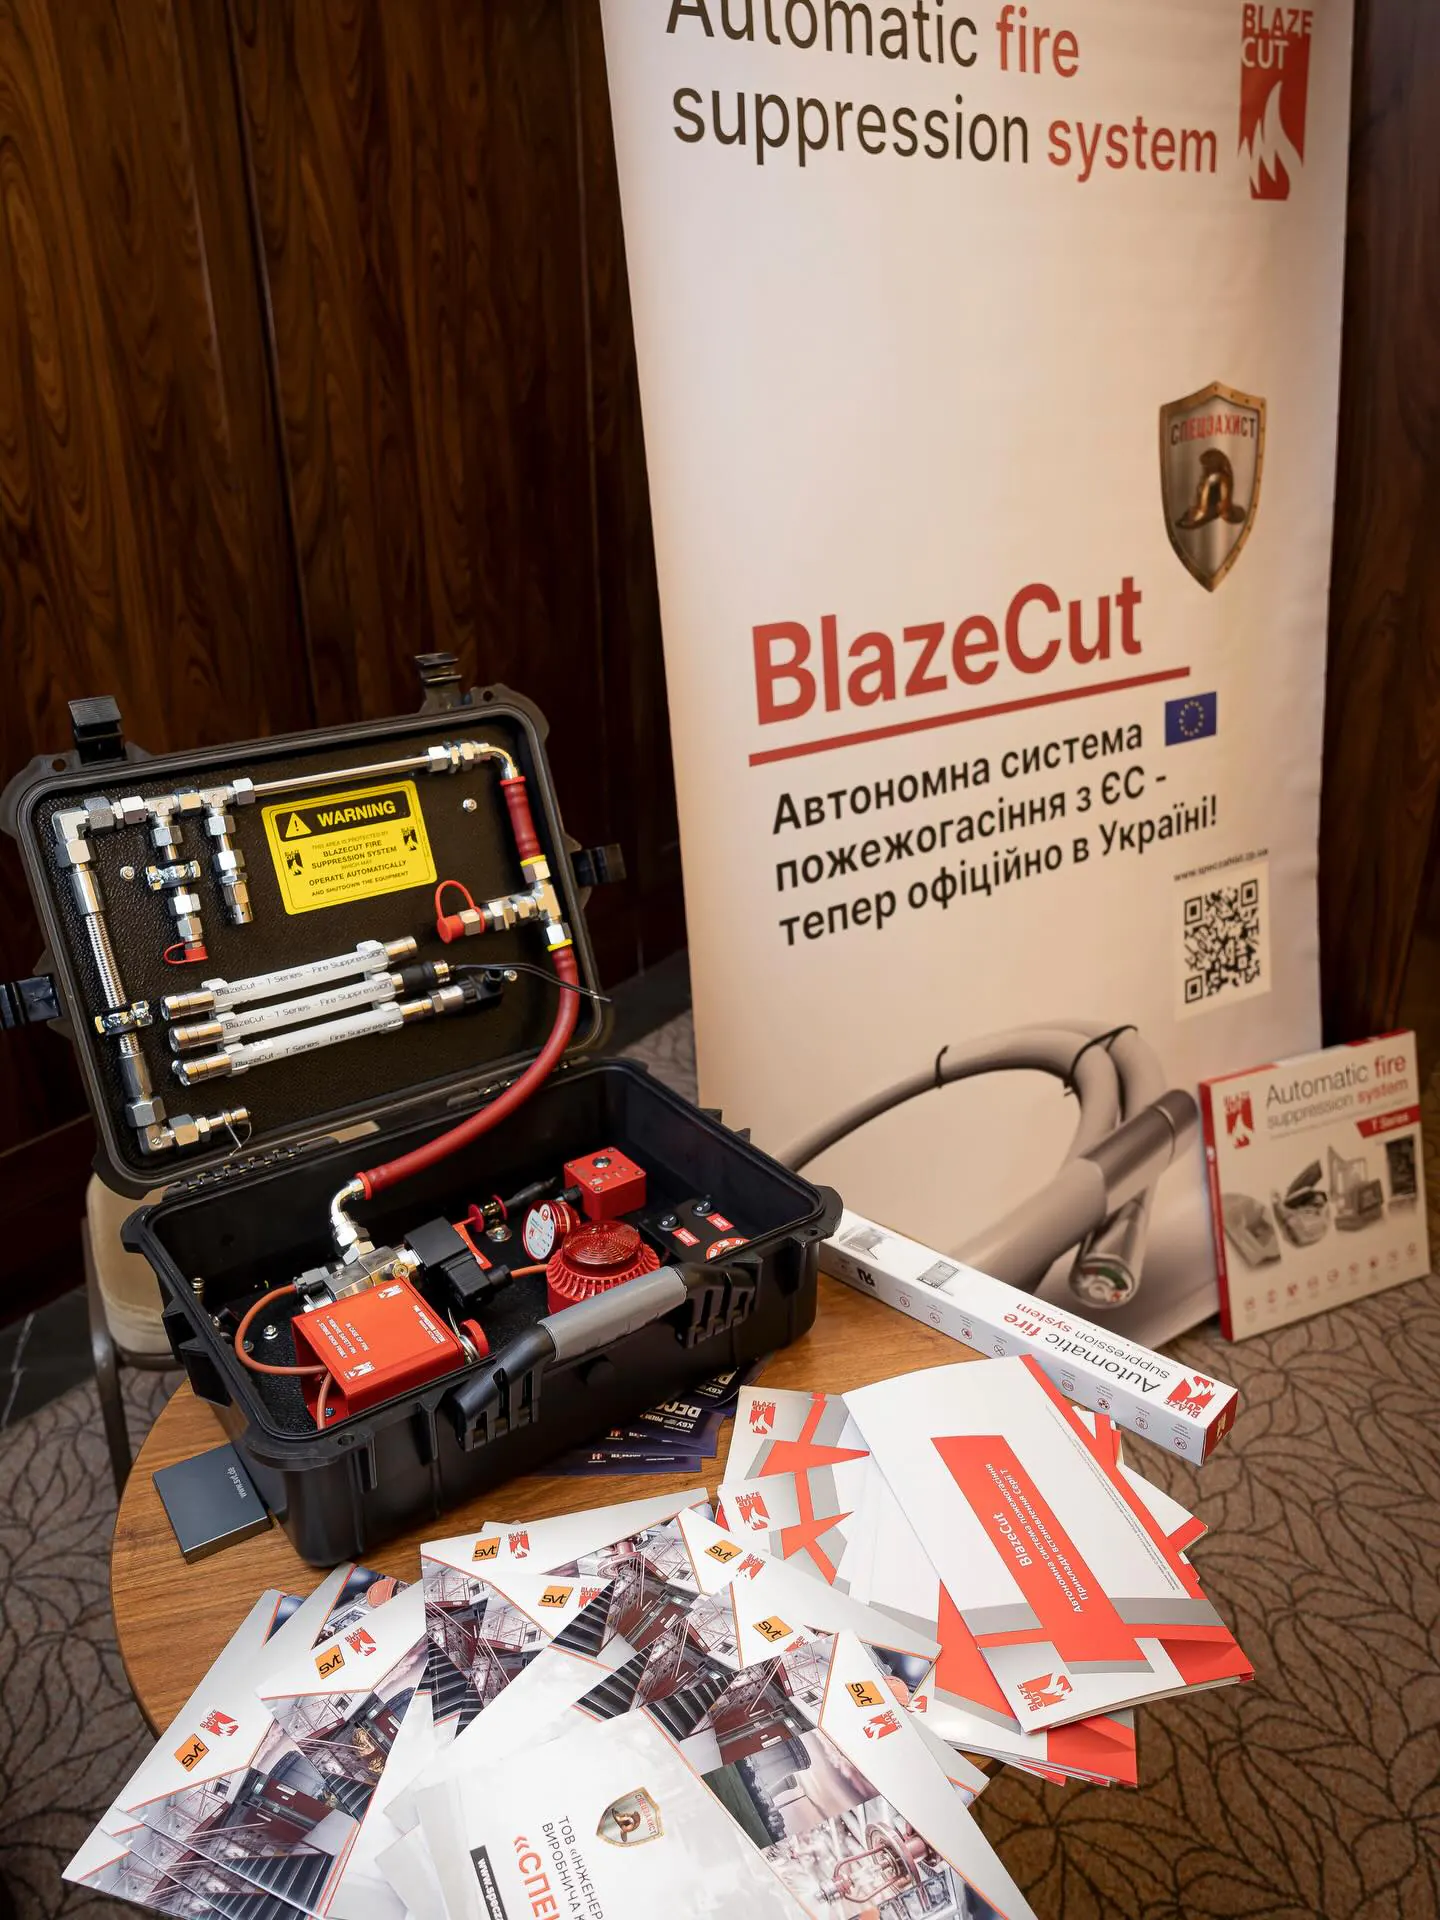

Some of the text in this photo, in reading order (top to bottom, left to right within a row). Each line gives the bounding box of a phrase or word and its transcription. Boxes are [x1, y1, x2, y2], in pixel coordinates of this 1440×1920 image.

[1242, 3, 1314, 38] BLAZE
[996, 4, 1080, 78] fire
[1240, 36, 1289, 70] CUT
[673, 87, 1218, 183] suppression system
[1171, 412, 1257, 446] СПЕЦЗАХИСТ
[752, 576, 1143, 726] BlazeCut
[772, 723, 1143, 835] Автономна система
[317, 800, 397, 827] WARNING
[775, 791, 1067, 892] пожежогасіння
[1076, 786, 1093, 814] з
[1101, 765, 1146, 806] ЄС
[311, 845, 397, 870] SUPPRESSION SYSTEM
[323, 839, 383, 858] BLAZECUT FIRE
[309, 860, 407, 887] OPERATE AUTOMATICALLY
[312, 871, 409, 897] AND SHUTDOWN THE EQUIPMENT
[779, 794, 1218, 947] тепер офіційно в Україні!
[216, 981, 257, 997] BlazeCut
[274, 972, 303, 984] Series
[312, 965, 330, 975] Fire
[332, 949, 386, 970] Suppression
[225, 1016, 265, 1031] BlazeCut
[283, 1004, 312, 1017] Series
[320, 997, 337, 1007] Fire
[338, 981, 393, 1001] Suppression
[235, 1053, 274, 1069] BlazeCut
[291, 1040, 320, 1053] Series
[330, 1032, 346, 1043] Fire
[348, 1018, 401, 1038] Suppression
[1265, 1055, 1407, 1111] Automatic fire
[1267, 1078, 1409, 1129] suppression system
[1003, 1312, 1042, 1337] fire
[1016, 1303, 1073, 1333] system
[1045, 1332, 1161, 1394] Automatic
[1074, 1330, 1171, 1379] suppression
[752, 1400, 776, 1408] BLAZE
[1164, 1399, 1202, 1419] BLAZE
[735, 1491, 760, 1504] BLAZE
[1003, 1473, 1023, 1496] Серії
[508, 1530, 528, 1538] BLAZE
[984, 1462, 1083, 1615] Автономна система пожежогасіння
[992, 1510, 1033, 1569] BlazeCut
[1018, 1494, 1060, 1554] встановлення
[475, 1545, 497, 1558] svt
[709, 1545, 733, 1561] svt
[1056, 1553, 1090, 1602] Приклади
[541, 1594, 567, 1604] svt
[344, 1627, 362, 1642] BLAZE
[758, 1620, 782, 1639] svt
[319, 1654, 342, 1675] svt
[851, 1683, 873, 1704] svt
[1016, 1683, 1040, 1711] BLAZE
[200, 1709, 217, 1728] BLAZE
[886, 1710, 903, 1729] BLAZE
[181, 1742, 205, 1767] svt
[542, 1822, 582, 1913] ВИРОБНИЧА
[558, 1816, 604, 1920] ТОВ «ІНЖЕНЕР
[477, 1857, 505, 1920] www.specz
